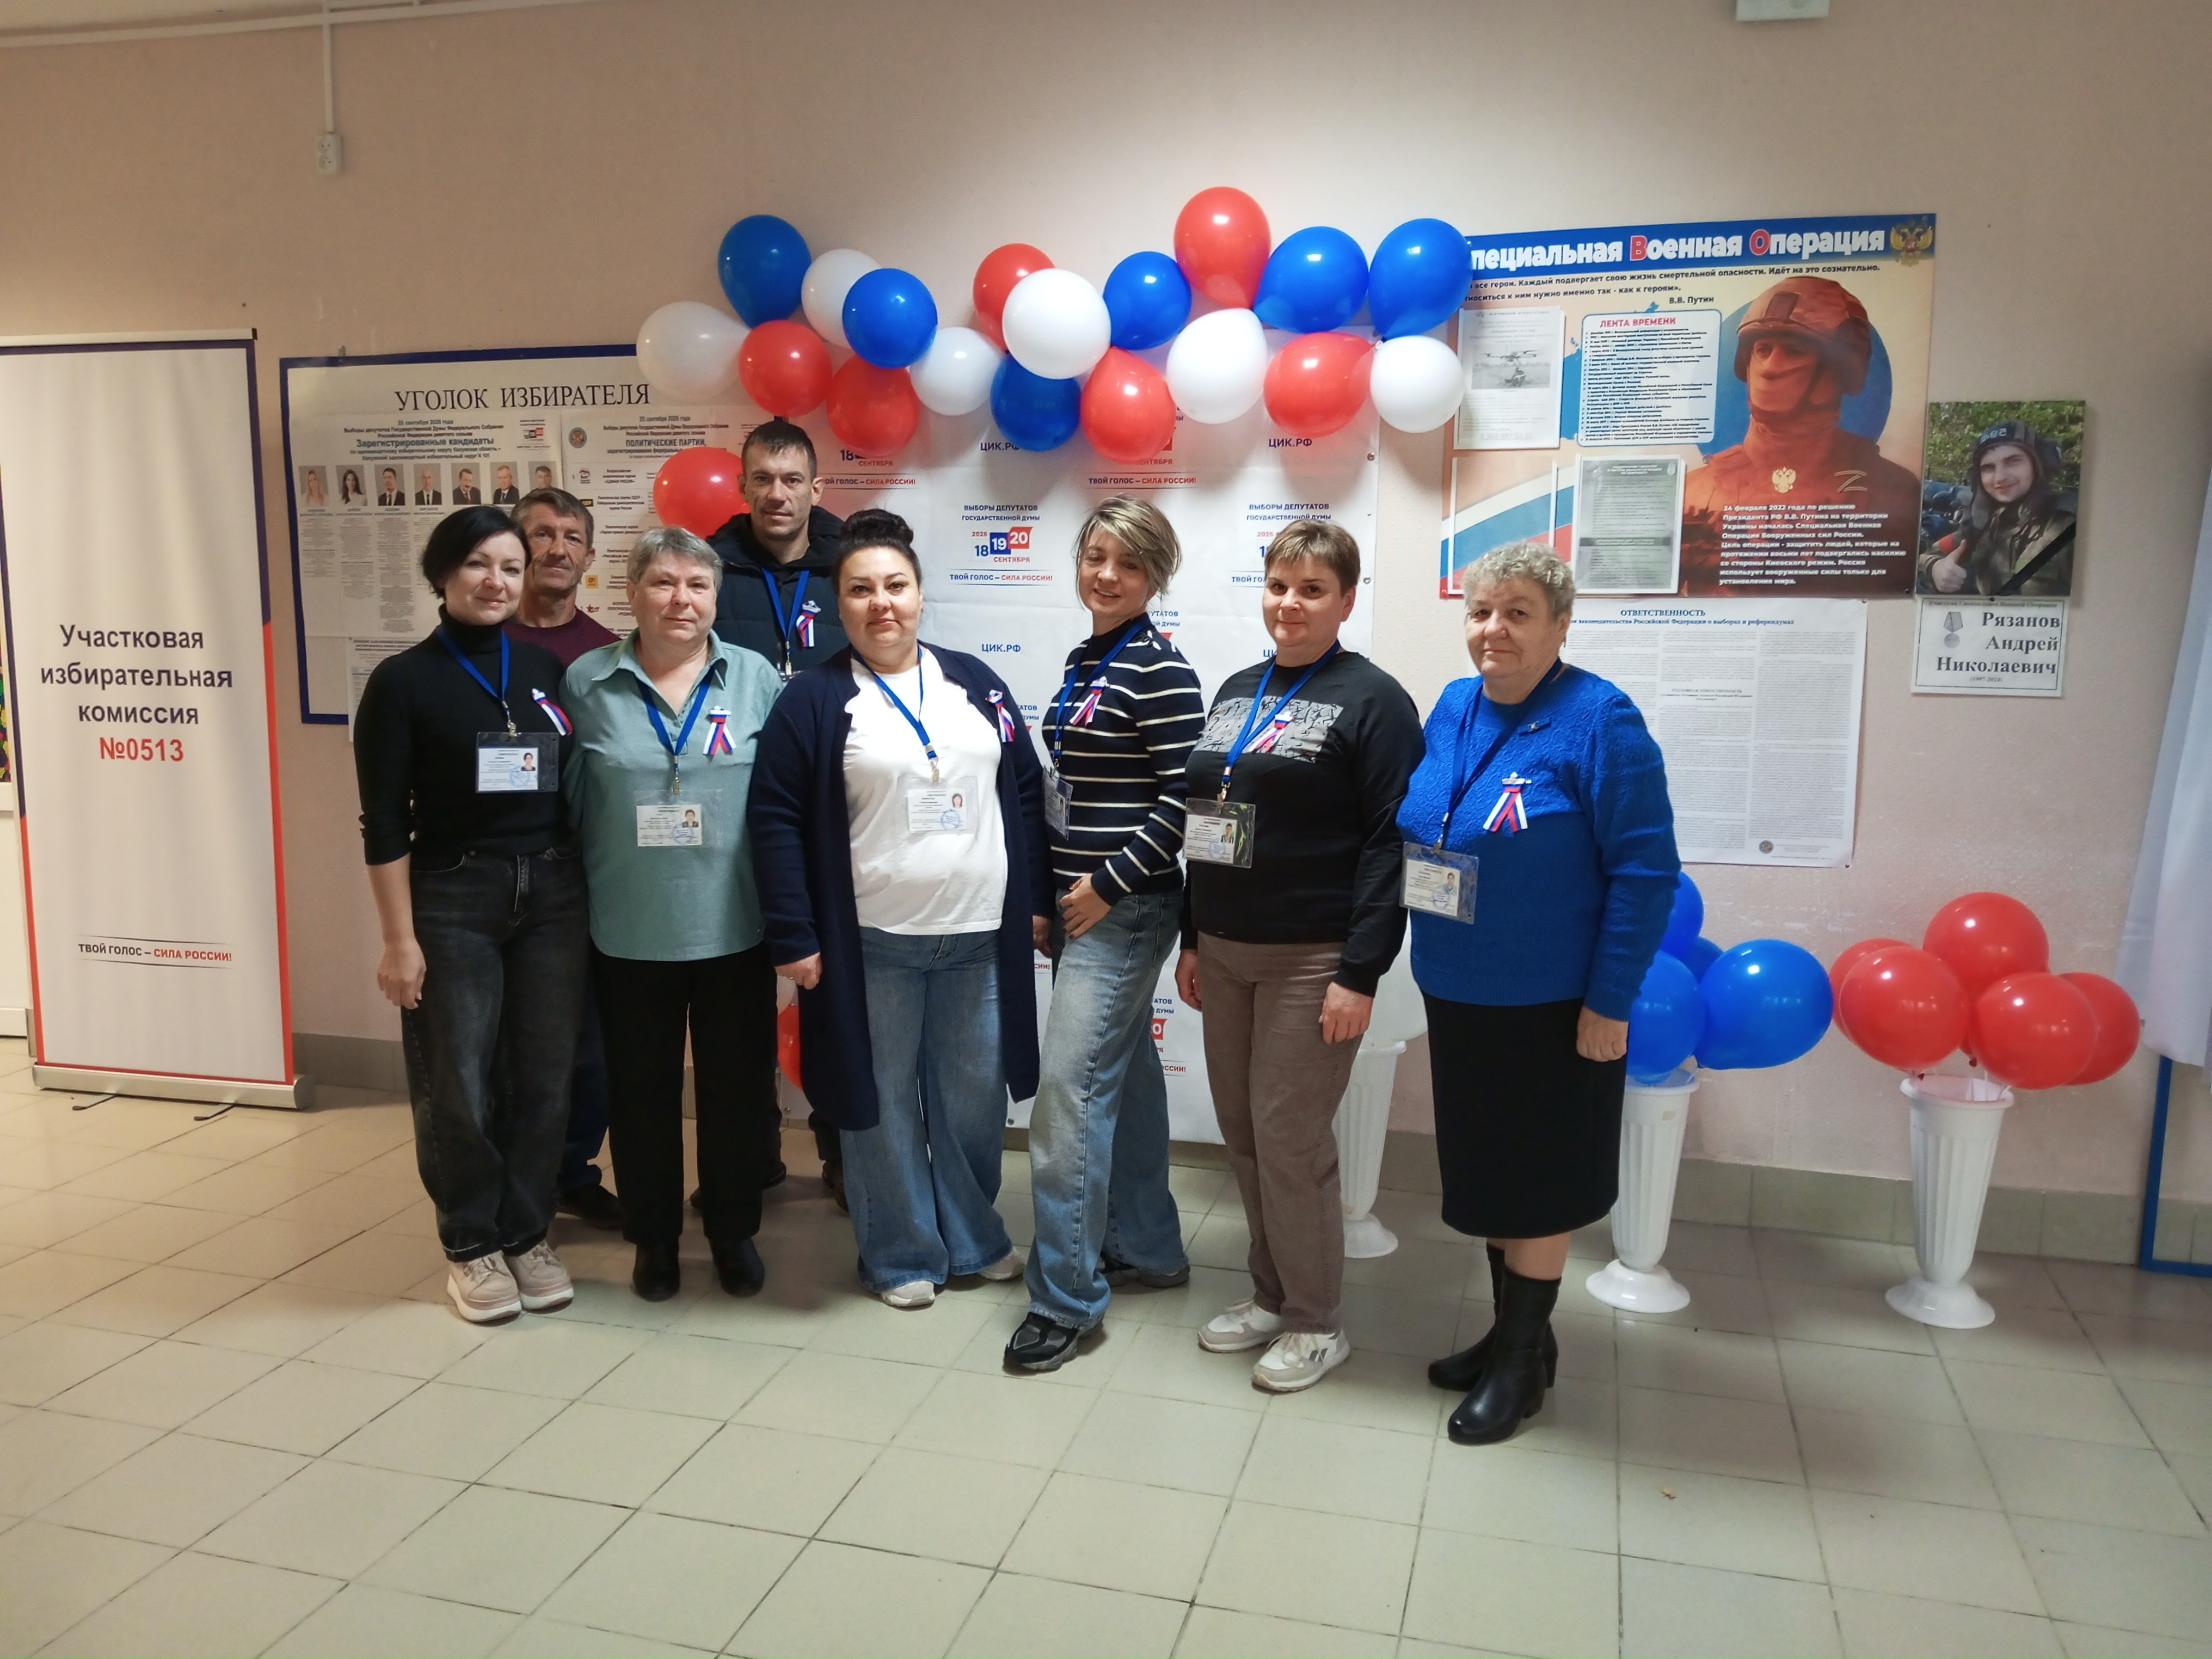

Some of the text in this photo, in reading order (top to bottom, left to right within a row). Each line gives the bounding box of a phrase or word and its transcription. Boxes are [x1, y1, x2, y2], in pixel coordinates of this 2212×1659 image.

[1471, 229, 1885, 271] пециальная Военная Операция
[1491, 280, 1516, 290] герои.
[1519, 277, 1553, 287] Каждый
[1556, 275, 1603, 285] подвергает
[1659, 269, 1716, 279] смертельной
[1768, 266, 1790, 275] Идёт
[1822, 265, 1880, 273] сознательно.
[1533, 290, 1560, 300] нужно
[1563, 288, 1595, 297] именно
[1687, 296, 1714, 305] Путин
[1600, 317, 1676, 328] ЛЕНТА ВРЕМЕНИ
[394, 383, 651, 411] УГОЛОК ИЗБИРАТЕЛЯ
[356, 438, 494, 448] Зарегистрированные кандидаты
[626, 439, 677, 447] ПОЛИТИЧЕСКИЕ
[1268, 438, 1312, 448] ЦИК.РФ
[840, 448, 855, 461] 18
[1834, 470, 1867, 493] Z
[1734, 504, 1767, 512] февраля
[1818, 503, 1856, 512] решению
[1800, 513, 1829, 521] Путина
[1841, 513, 1888, 521] территории
[1723, 523, 1757, 531] Украины
[1761, 532, 1816, 540] Вооруженных
[975, 531, 1028, 557] 18 19 20
[1721, 541, 1741, 549] Цель
[1824, 540, 1853, 549] людей,
[1259, 545, 1267, 557] 1
[1815, 550, 1870, 558] подвергались
[1719, 569, 1764, 577] использует
[1765, 569, 1819, 577] вооруженные
[1719, 578, 1796, 586] установления мира.
[1982, 612, 2061, 628] Рязанов
[59, 624, 204, 649] Участковая
[981, 643, 1021, 653] ЦИК.РФ
[1986, 635, 2059, 654] Андрей
[1936, 656, 2057, 674] Николаевич
[41, 661, 233, 691] избирательная
[78, 705, 199, 724] комиссия
[99, 736, 184, 761] №0513
[78, 943, 232, 962] ТВОЙ ГОЛОС СИЛА РОССИИ!
